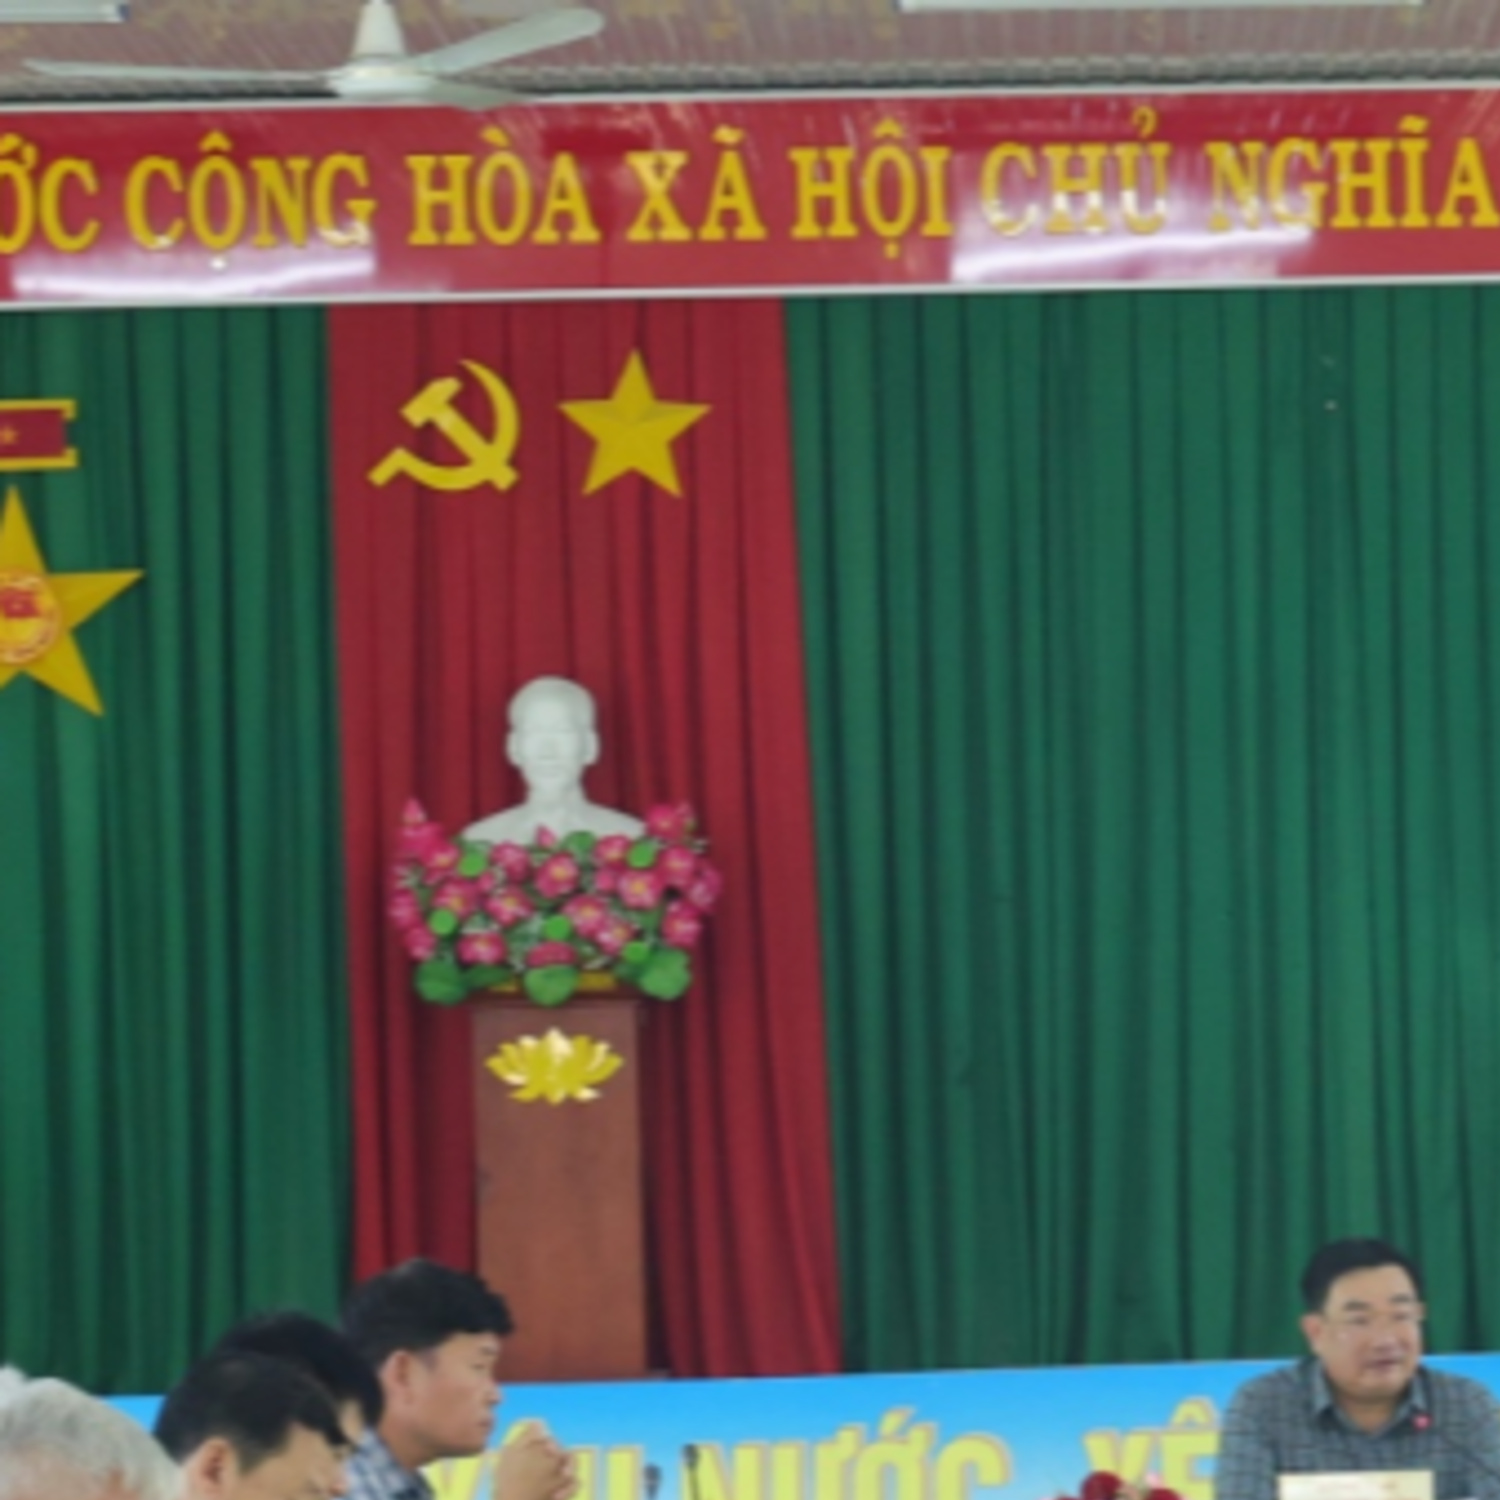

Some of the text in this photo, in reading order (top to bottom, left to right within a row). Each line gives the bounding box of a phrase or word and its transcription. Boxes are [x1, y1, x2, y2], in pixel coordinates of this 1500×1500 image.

[126, 131, 378, 269] CỘNG
[408, 127, 600, 246] HÒA
[627, 125, 766, 244] XÃ
[792, 118, 952, 260] HỘI
[980, 106, 1168, 236] CHỦ
[1206, 114, 1500, 230] NGHĨA
